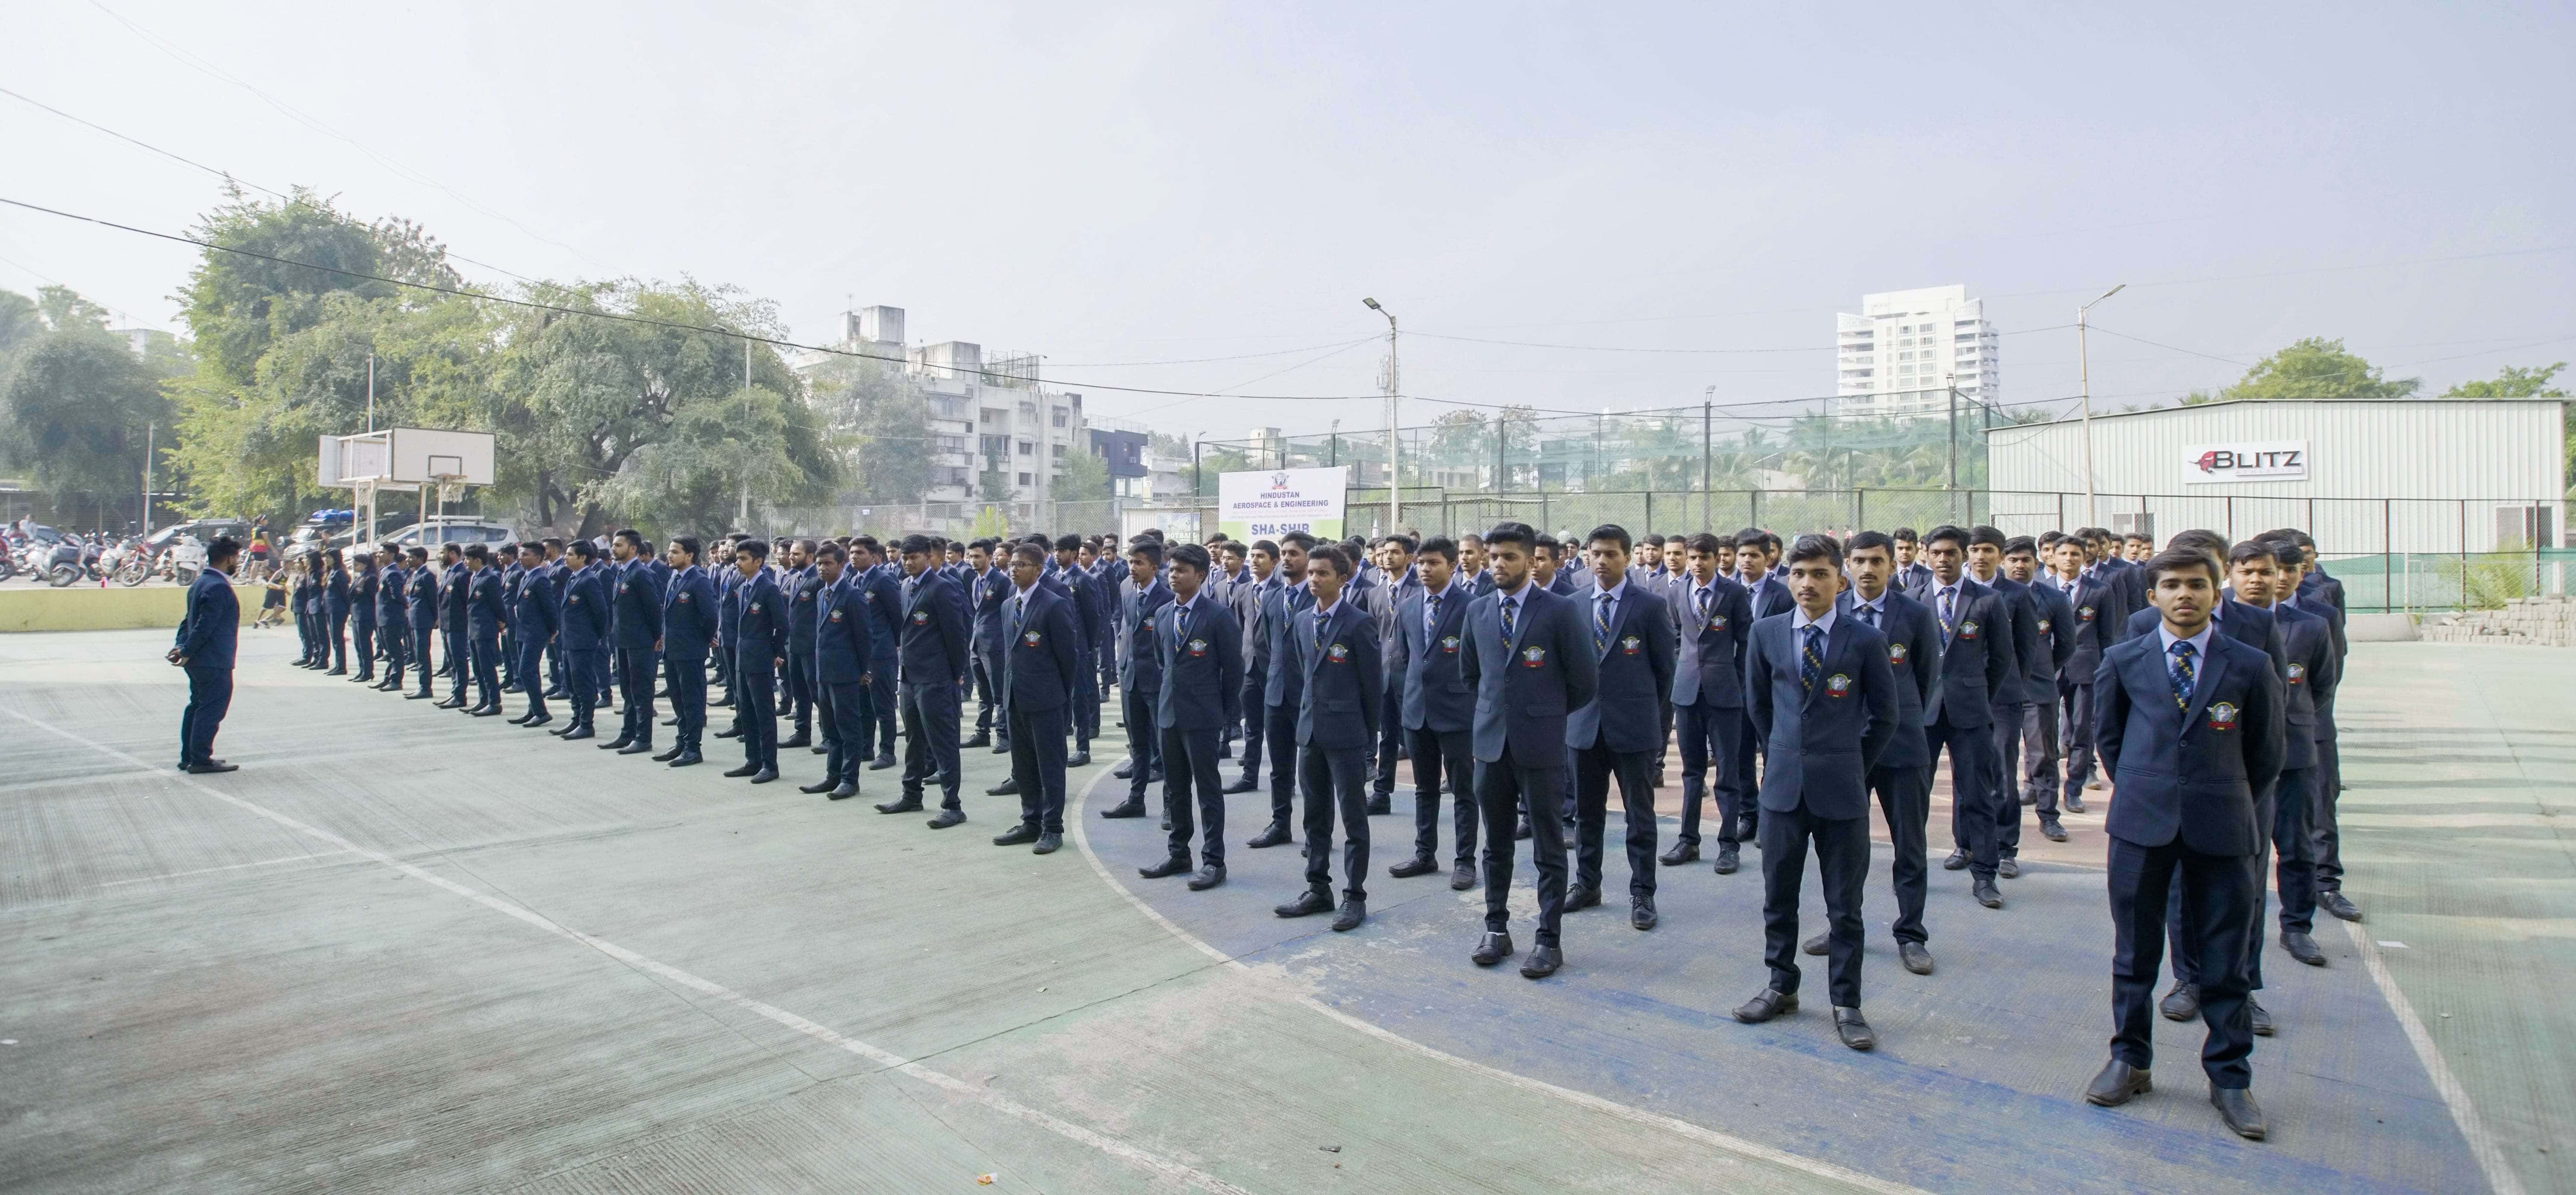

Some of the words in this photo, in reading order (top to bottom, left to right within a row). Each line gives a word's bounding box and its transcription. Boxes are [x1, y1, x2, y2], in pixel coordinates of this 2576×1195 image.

[2214, 450, 2301, 468] BLITZ
[1233, 501, 1272, 509] AEROSPACE
[1280, 500, 1329, 508] ENGINEERING
